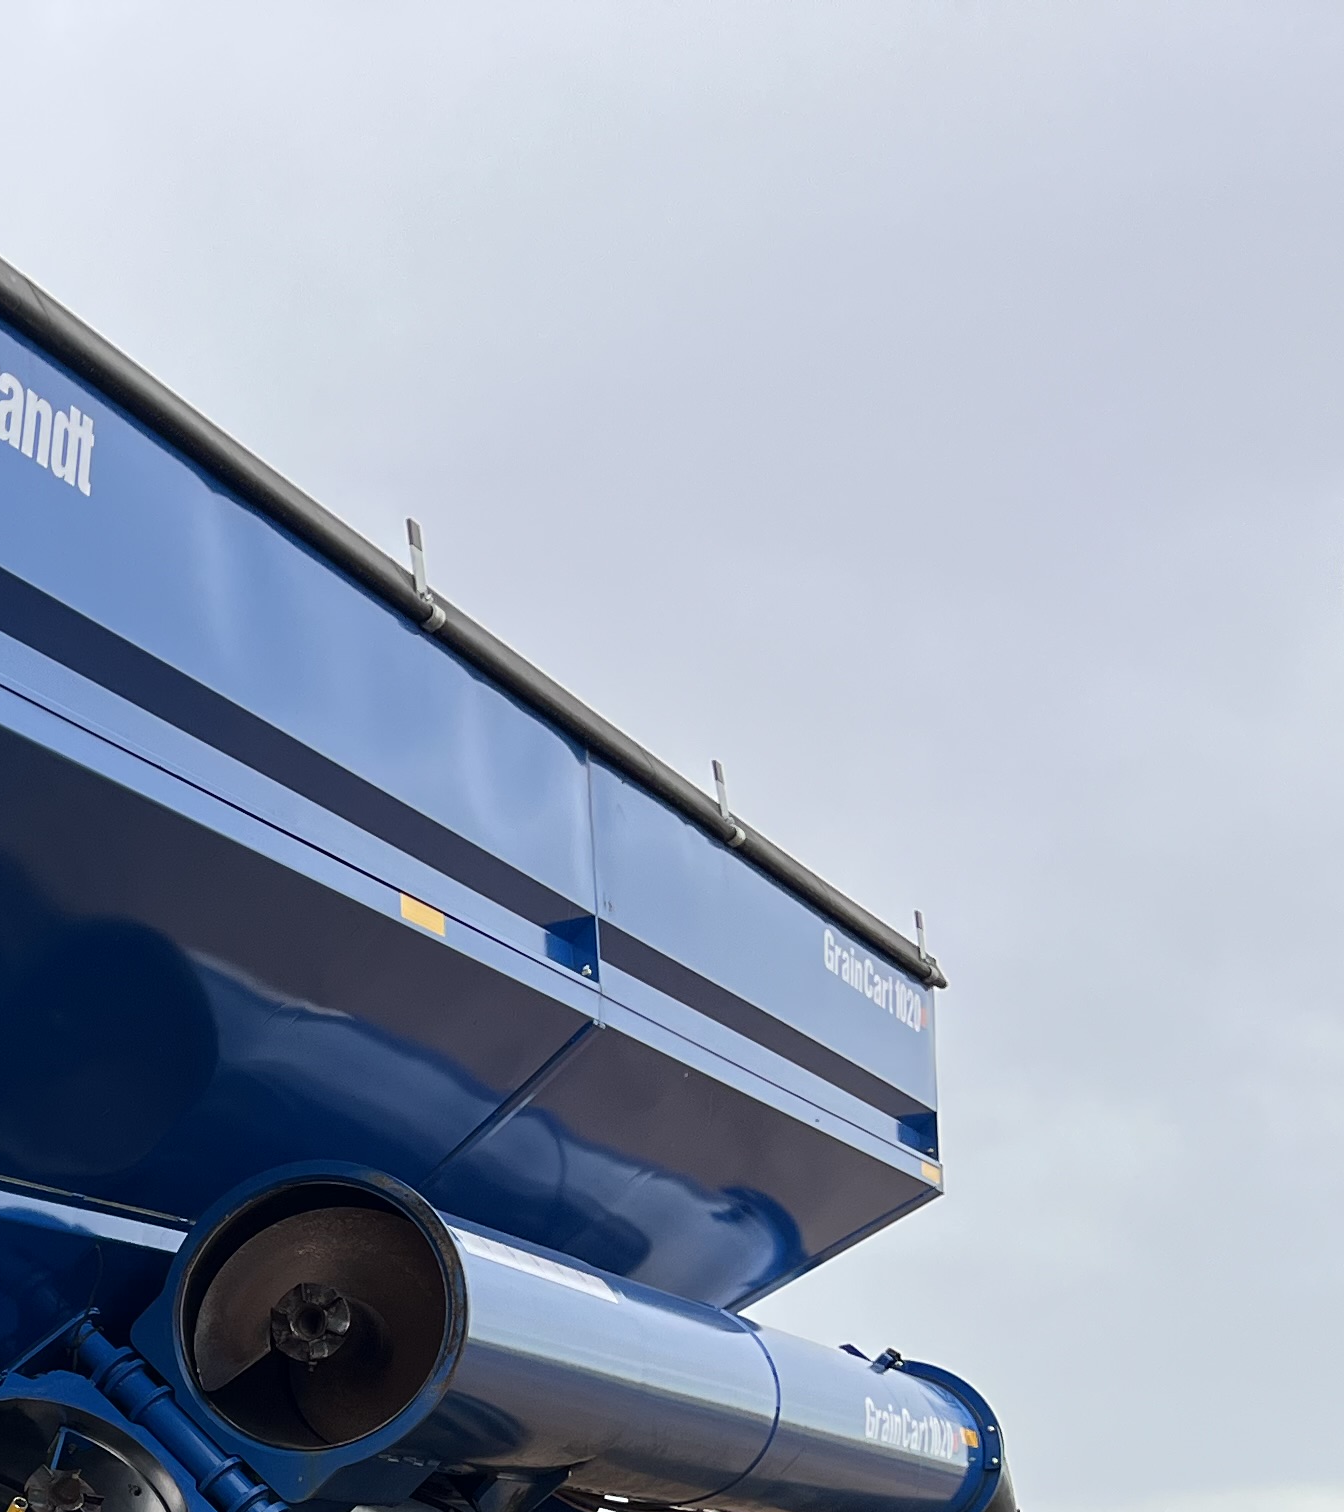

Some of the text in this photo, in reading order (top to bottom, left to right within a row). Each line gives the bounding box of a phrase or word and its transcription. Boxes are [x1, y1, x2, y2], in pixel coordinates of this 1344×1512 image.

[823, 928, 922, 1033] GrainCart 1020
[865, 1396, 929, 1454] GrainCart
